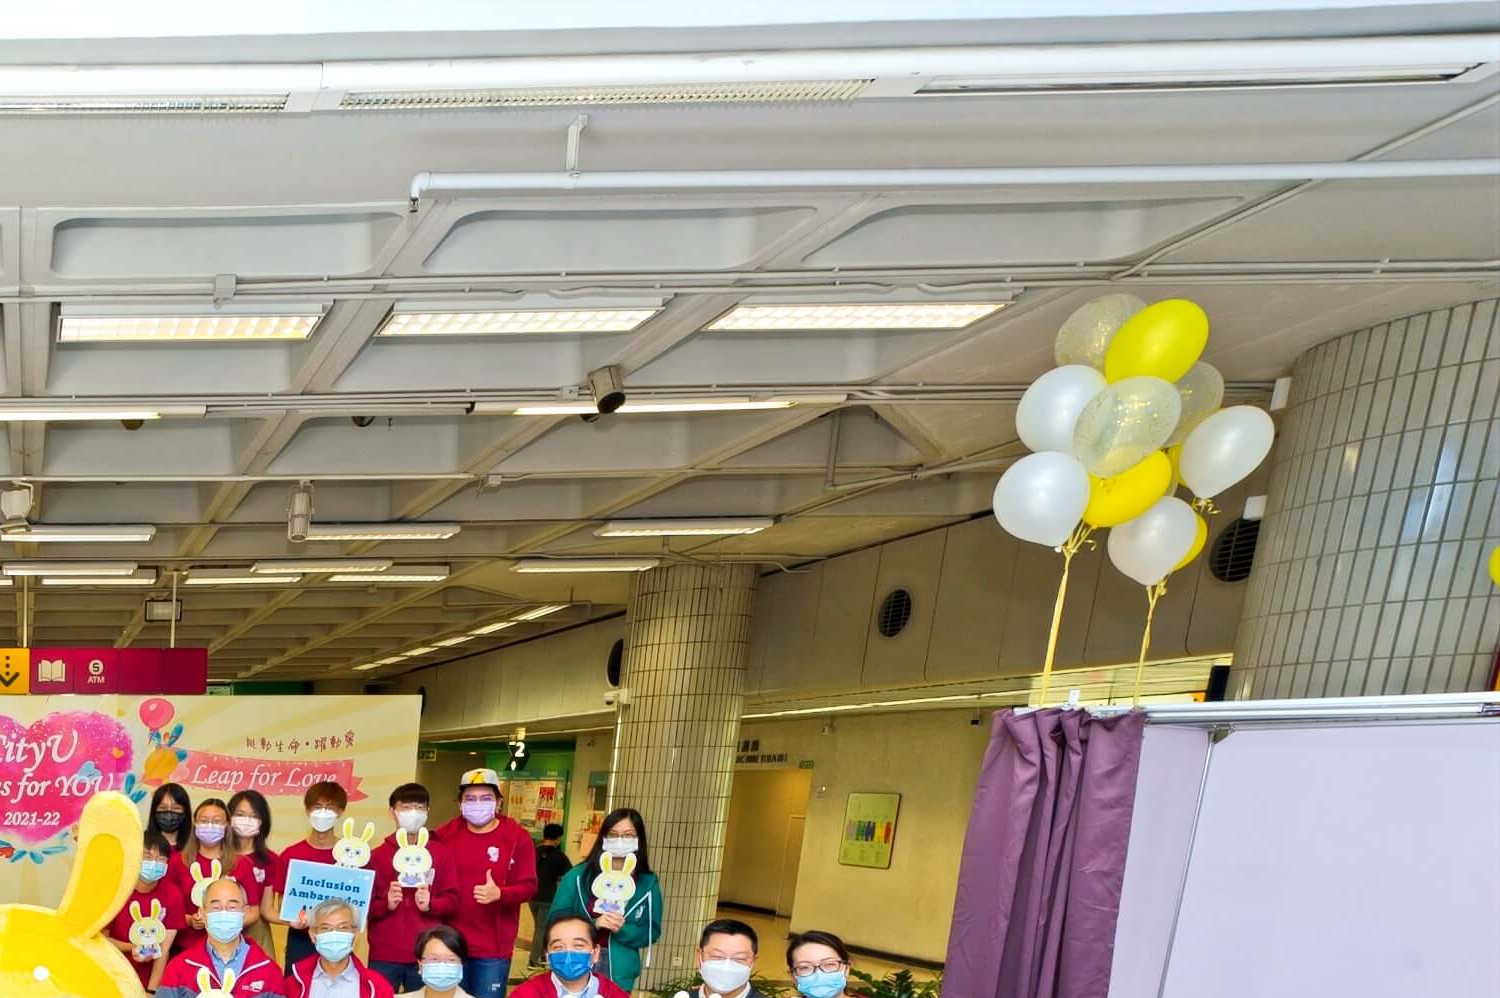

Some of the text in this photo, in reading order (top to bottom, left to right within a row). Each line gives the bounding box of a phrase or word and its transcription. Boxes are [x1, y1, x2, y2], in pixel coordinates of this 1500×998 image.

[87, 676, 105, 684] ATM
[191, 764, 244, 789] Leap
[251, 763, 281, 791] for
[10, 773, 51, 804] for
[55, 773, 113, 797] YOU
[3, 811, 61, 826] 2021-22
[300, 876, 361, 893] Inclusion
